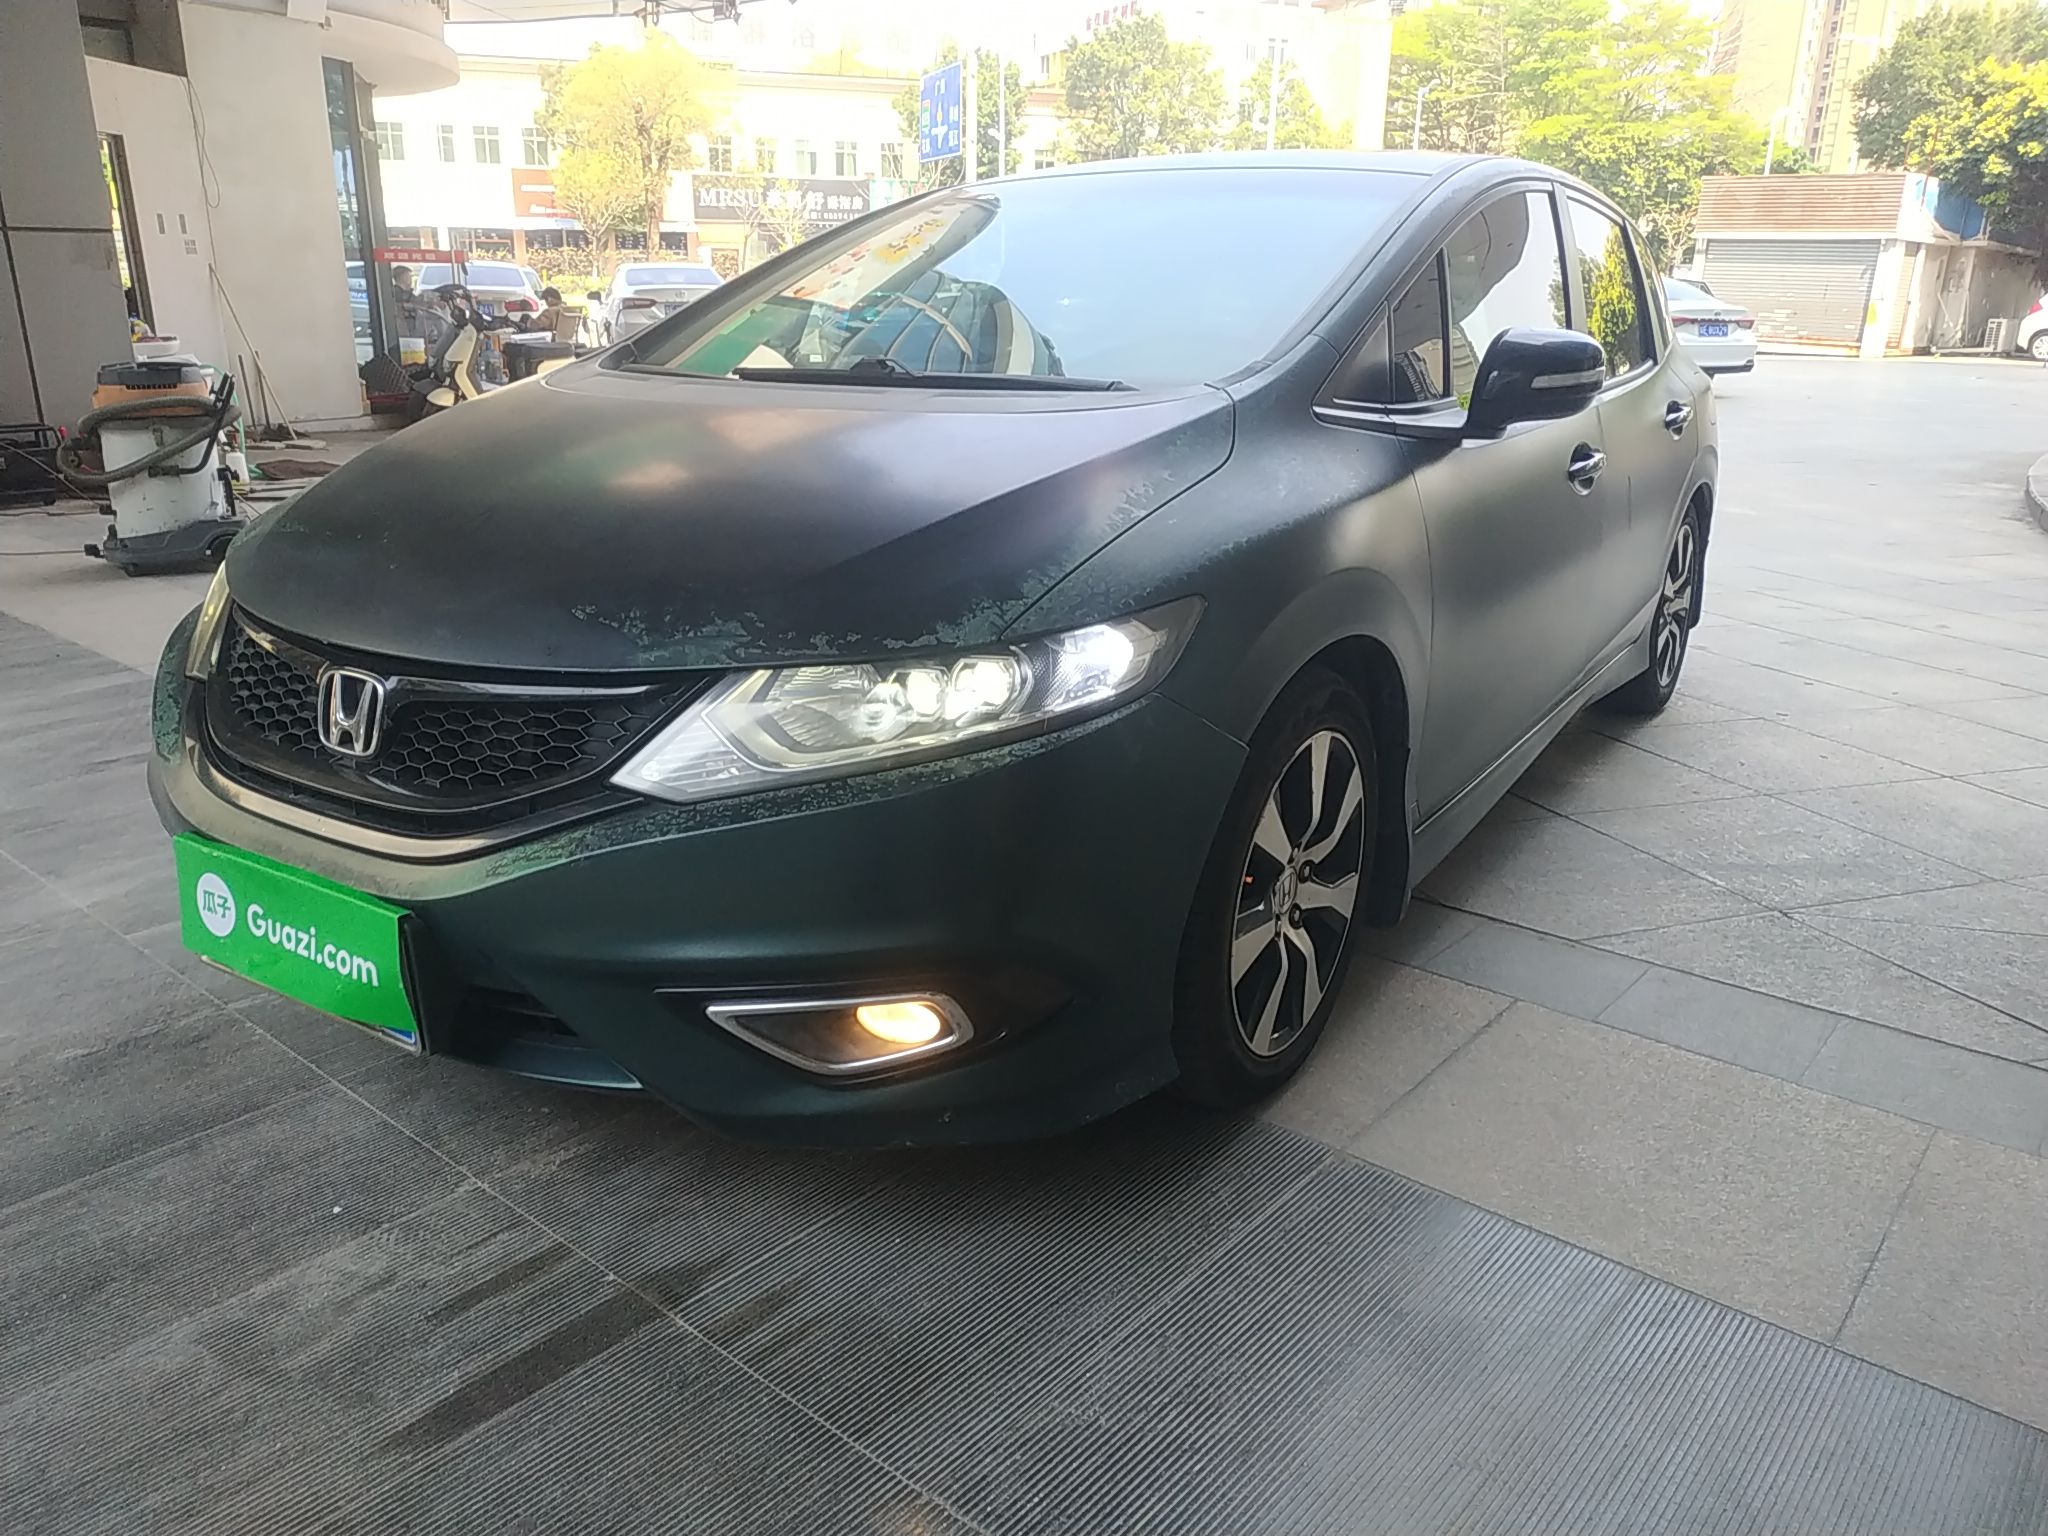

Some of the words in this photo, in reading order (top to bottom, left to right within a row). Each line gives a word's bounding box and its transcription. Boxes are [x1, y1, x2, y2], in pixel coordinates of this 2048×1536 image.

[698, 188, 763, 208] MRSU
[203, 889, 231, 918] 瓜子
[246, 903, 380, 988] Guazi.com
